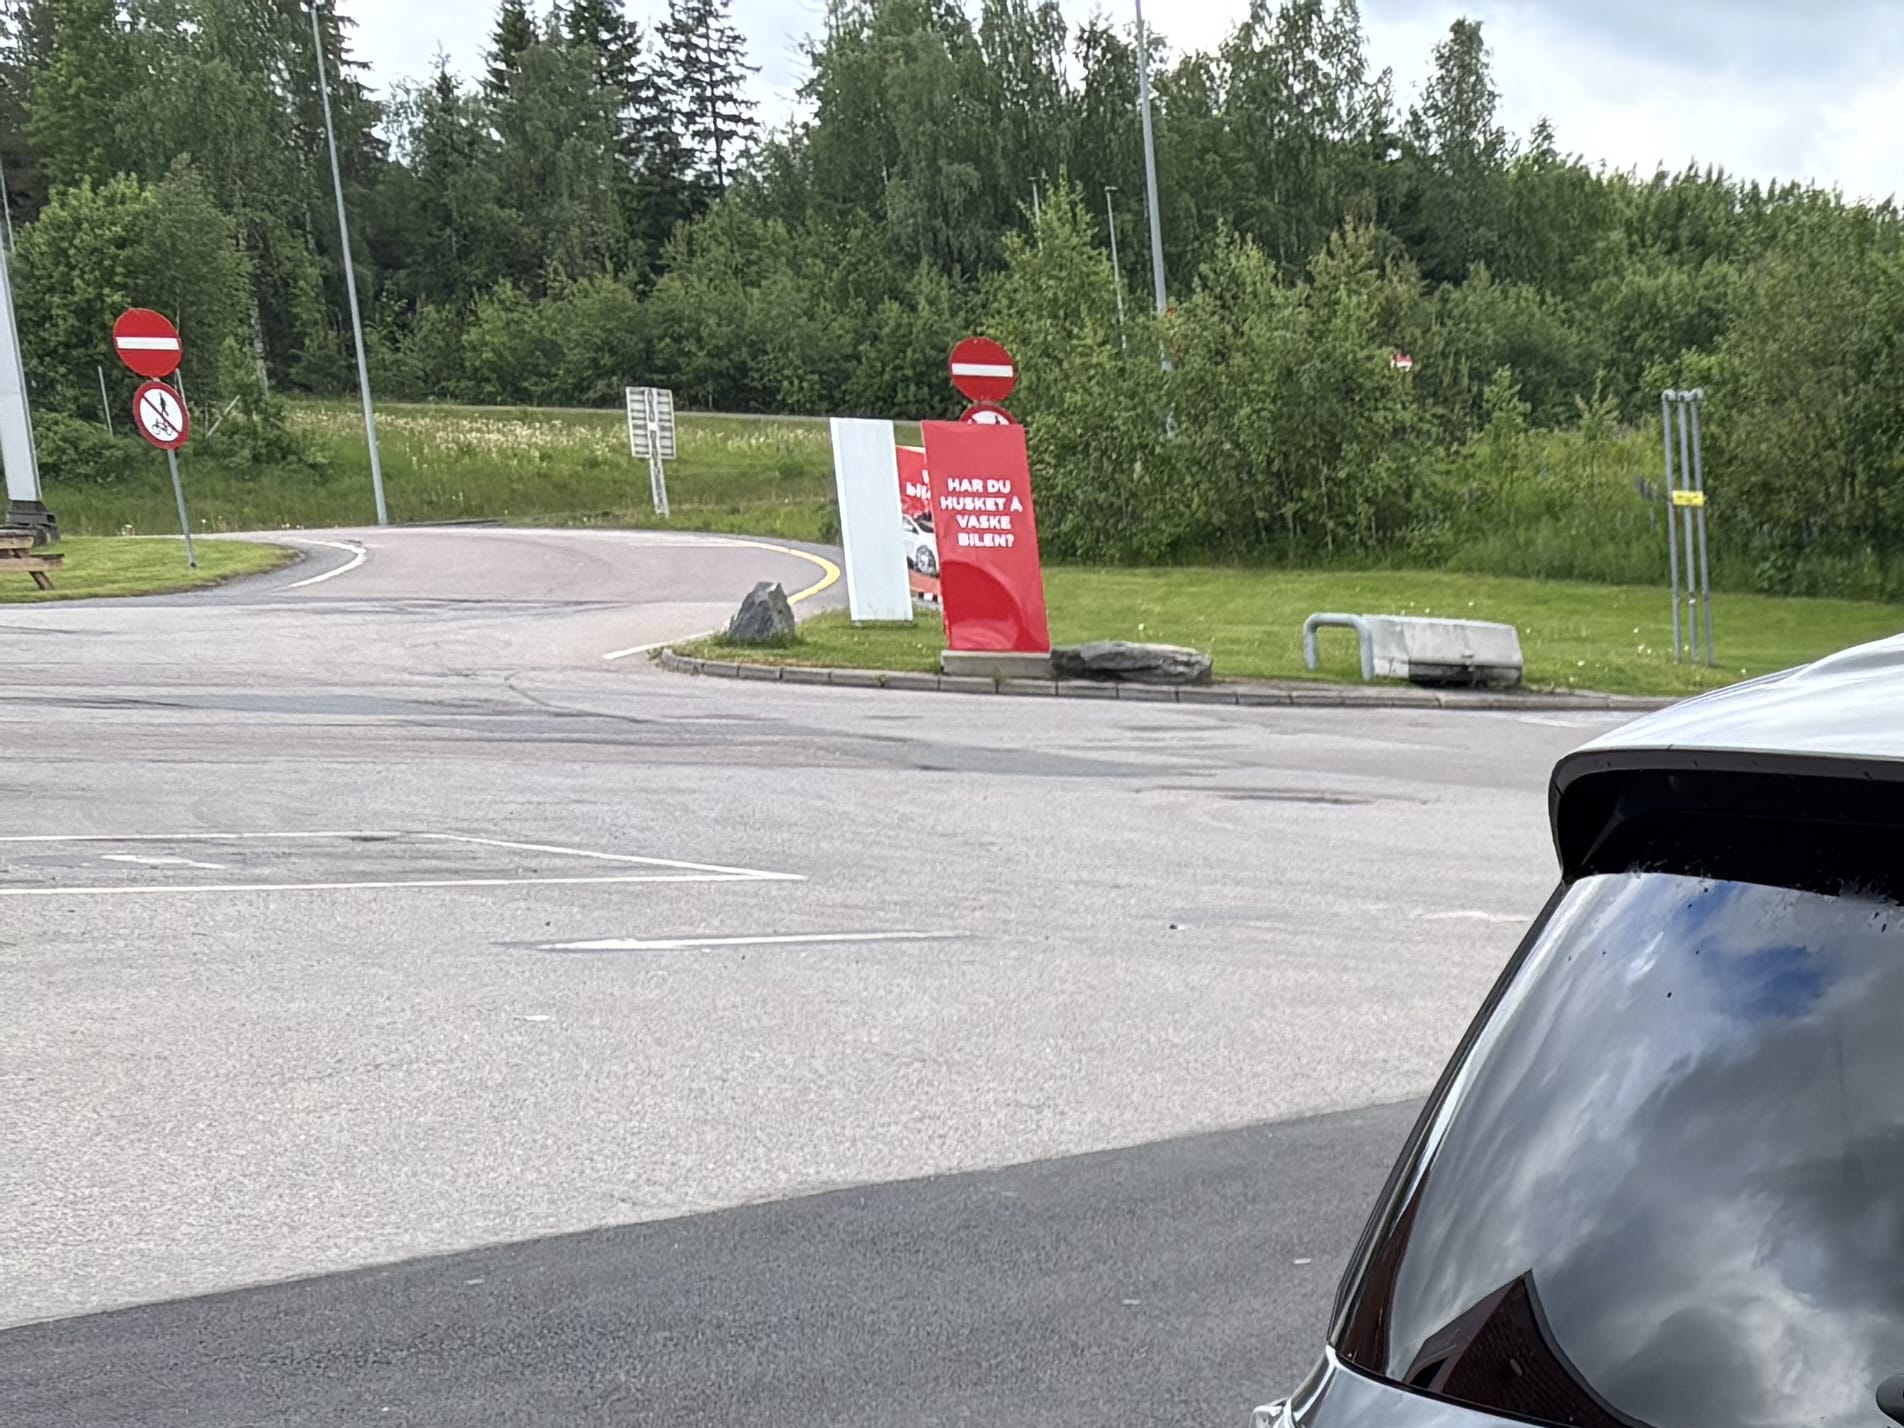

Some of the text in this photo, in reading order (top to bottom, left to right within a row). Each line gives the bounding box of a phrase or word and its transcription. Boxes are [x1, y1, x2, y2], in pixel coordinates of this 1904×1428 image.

[947, 478, 1011, 494] HAR DU
[940, 496, 1023, 512] HUSKET Å
[956, 514, 1012, 530] VASKE
[957, 533, 1015, 548] BILEN?
